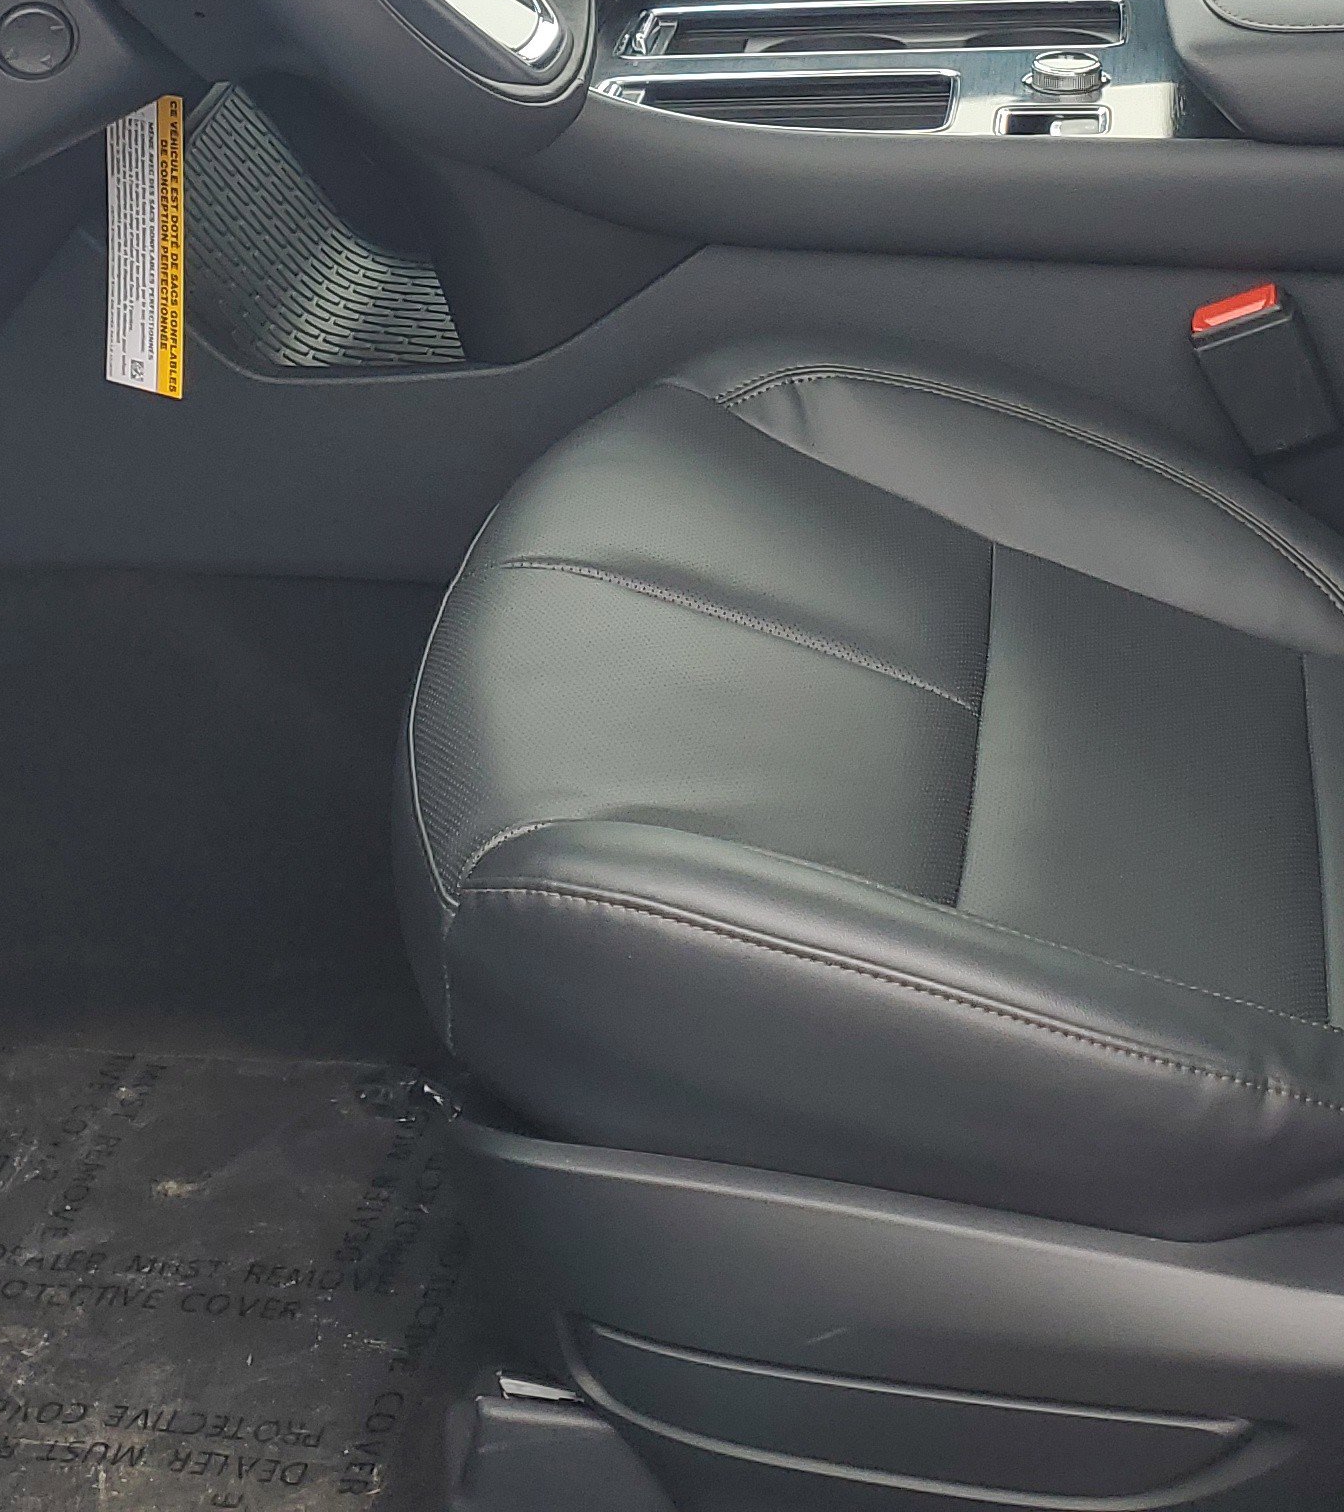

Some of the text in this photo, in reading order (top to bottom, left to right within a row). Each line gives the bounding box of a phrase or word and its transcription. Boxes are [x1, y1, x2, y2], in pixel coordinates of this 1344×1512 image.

[169, 100, 178, 117] CE
[160, 139, 169, 157] DE
[160, 159, 169, 242] CONCEPTION
[170, 186, 178, 213] EST
[170, 214, 180, 249] DOTÉ
[170, 252, 178, 270] DE
[170, 273, 178, 307] SACS
[180, 1290, 303, 1322] COVER
[104, 1402, 325, 1449] PROTECTIVE
[36, 1439, 150, 1468] MUST
[168, 1448, 310, 1487] DEALER
